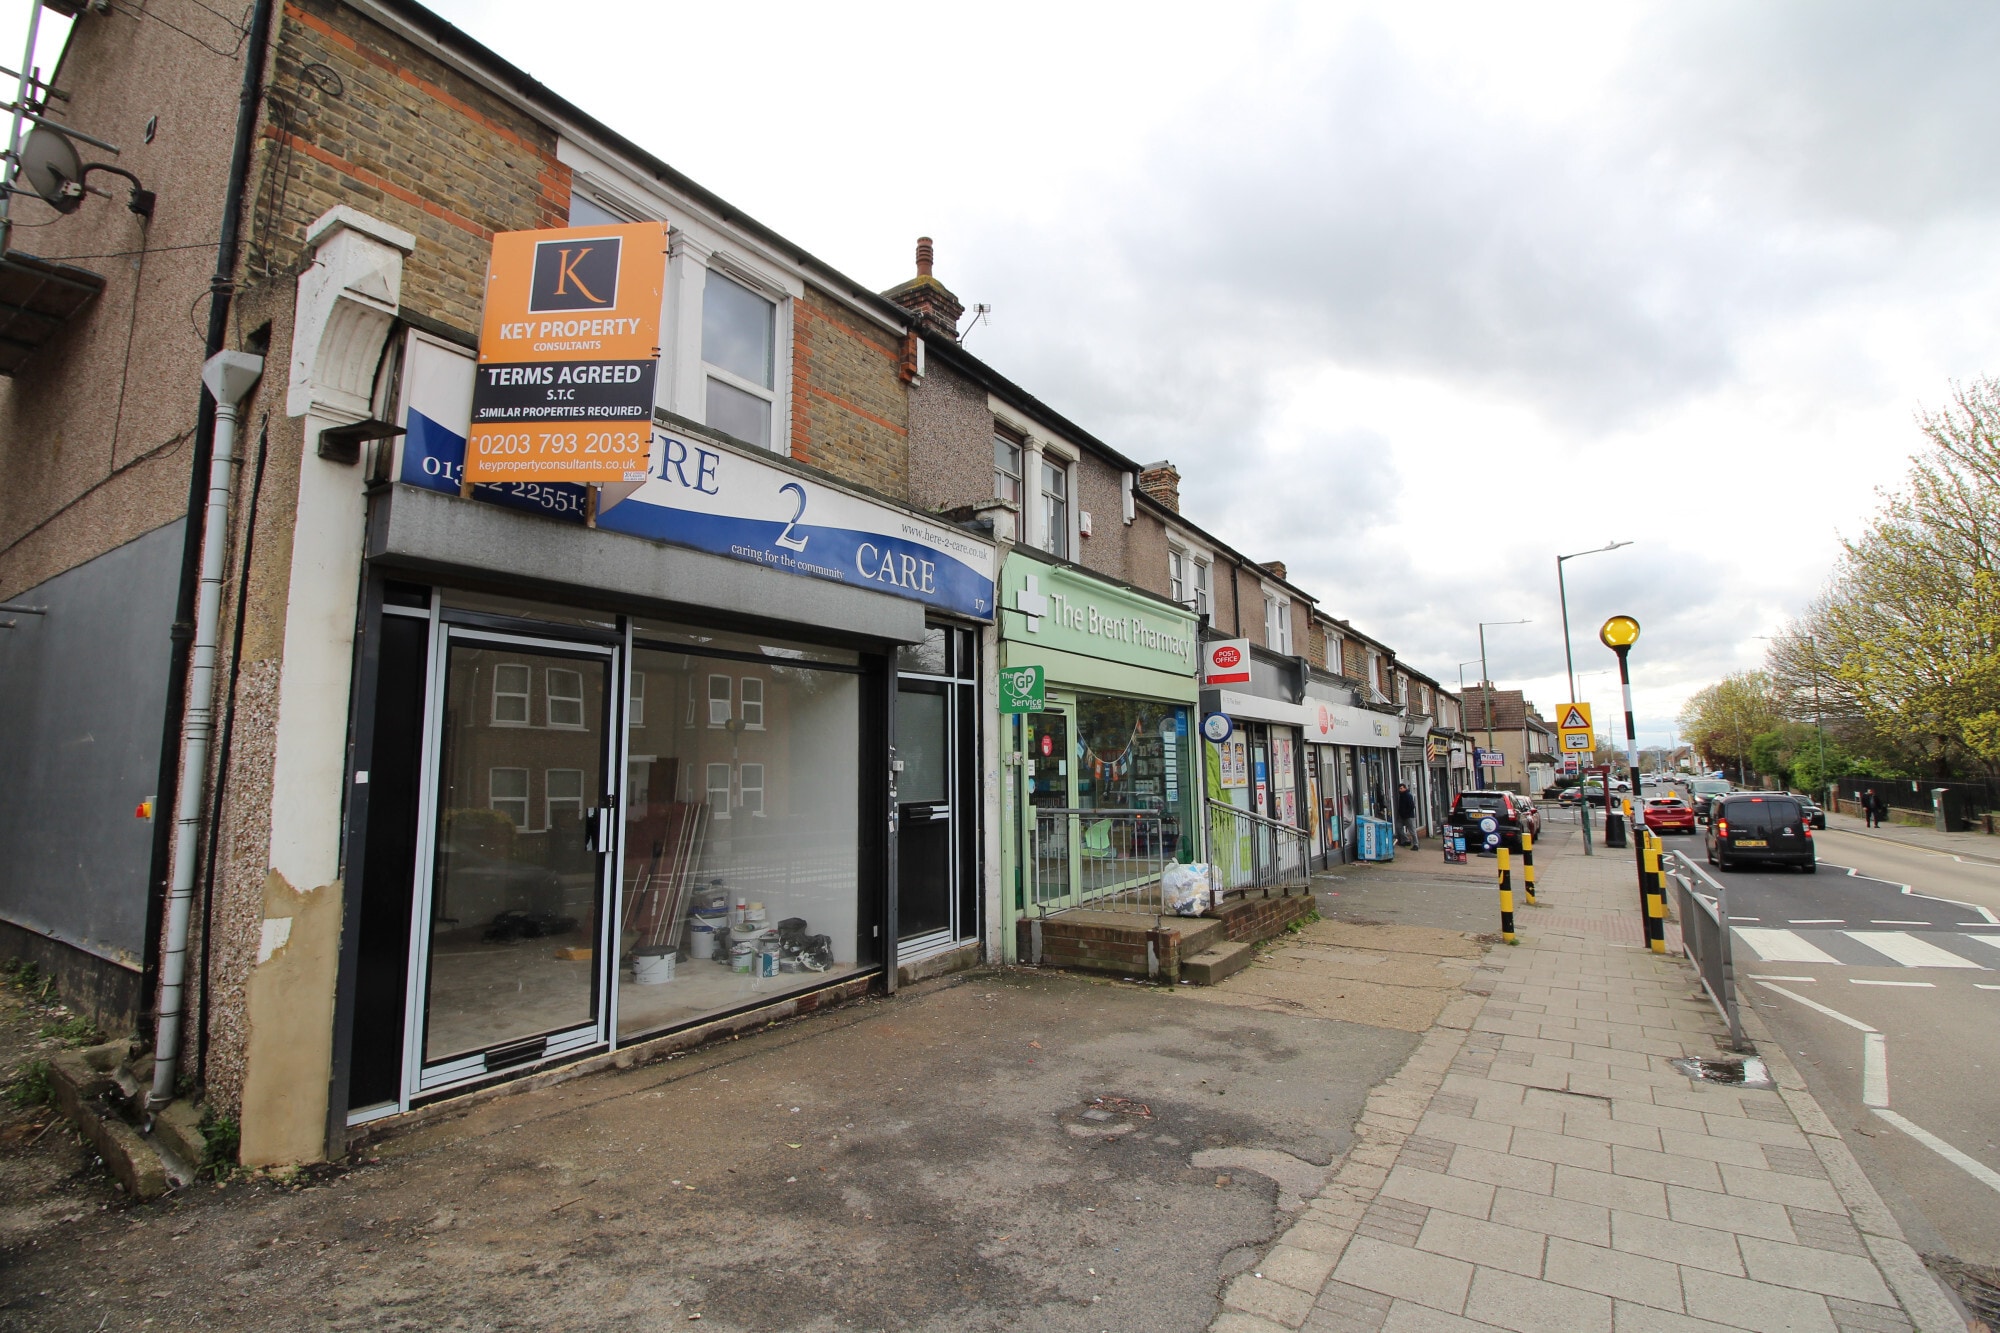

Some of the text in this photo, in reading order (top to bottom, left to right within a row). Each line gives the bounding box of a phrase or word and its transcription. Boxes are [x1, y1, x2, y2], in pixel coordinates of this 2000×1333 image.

[552, 248, 607, 303] K
[500, 317, 641, 340] KEY PROPERTY
[533, 340, 601, 352] CONSULTANTS
[488, 365, 642, 386] TERMS AGREED
[546, 388, 576, 401] S.T.C
[479, 405, 642, 418] SIMILAR PROPERTIES REQUIRED
[479, 432, 640, 455] 0203 793 2033
[479, 459, 636, 473] keypropertyconsultants.co.uk
[774, 482, 809, 552] 2
[855, 542, 936, 595] CARE
[901, 523, 988, 561] www.here-2-care.co.uk
[731, 544, 845, 582] caring for the community
[1050, 593, 1190, 664] The Brent Pharmacy
[1215, 655, 1238, 664] OFFICE
[1001, 672, 1034, 689] The GP
[1011, 698, 1042, 707] Service
